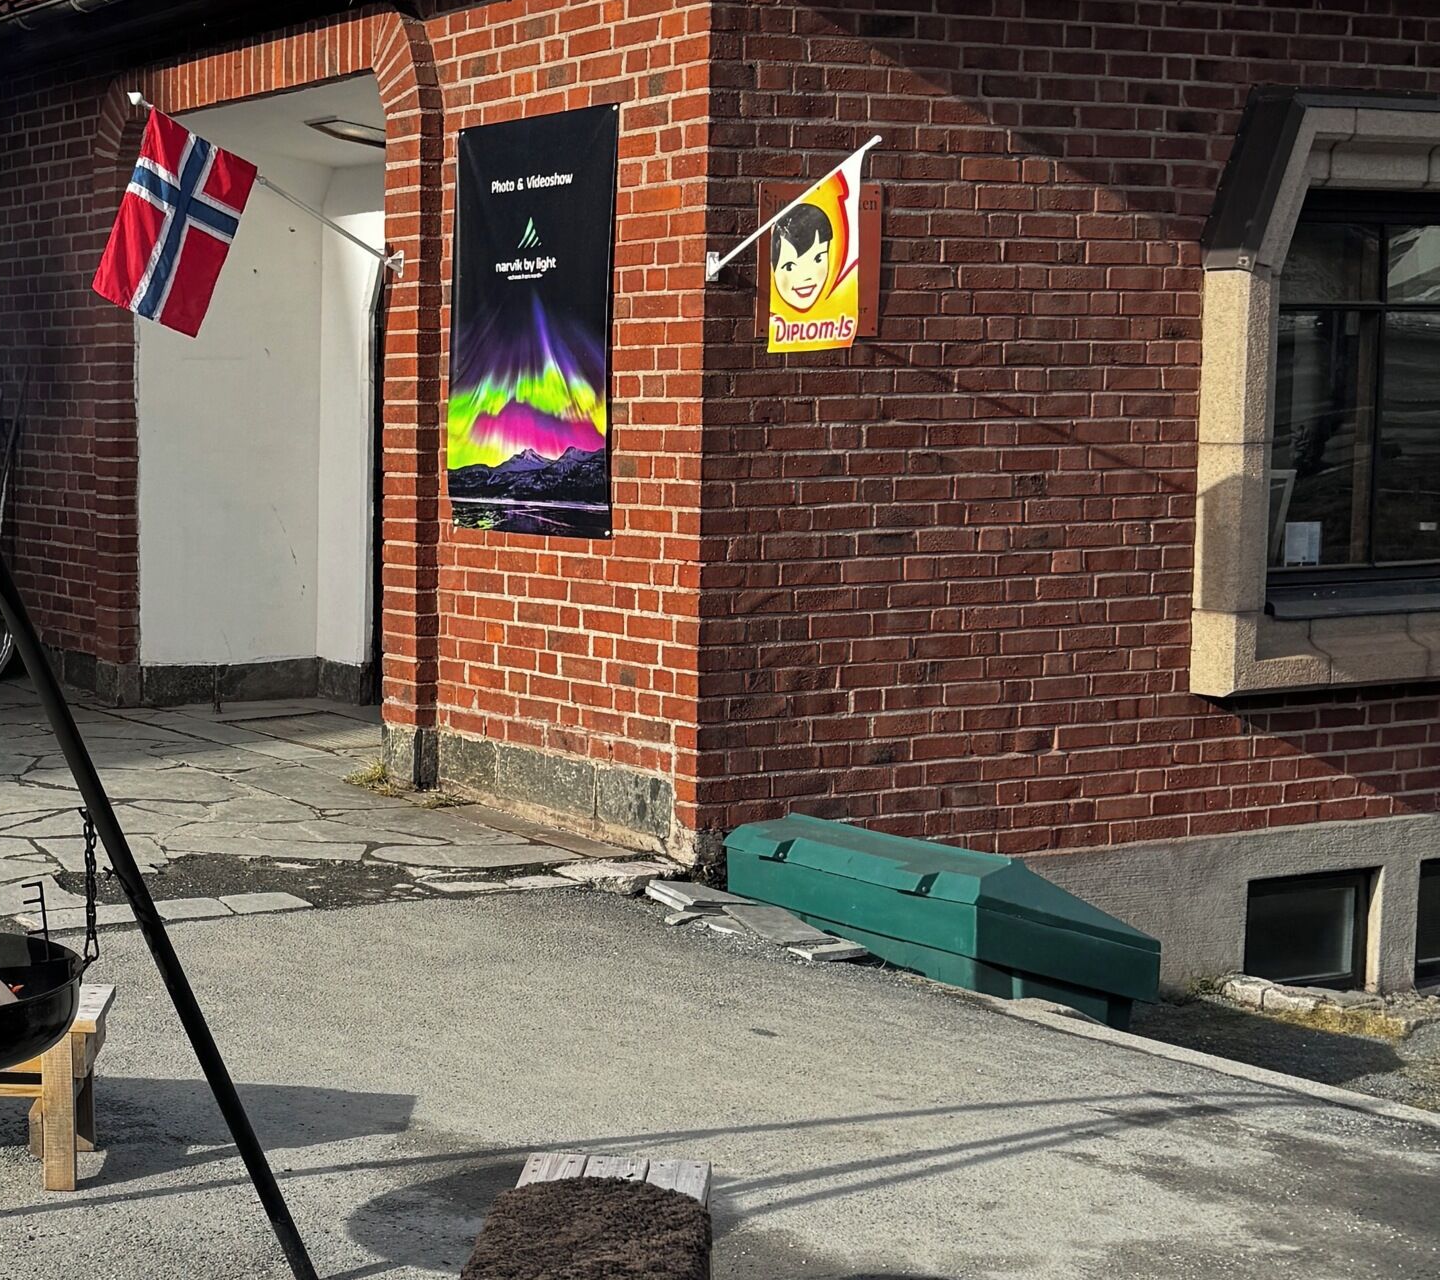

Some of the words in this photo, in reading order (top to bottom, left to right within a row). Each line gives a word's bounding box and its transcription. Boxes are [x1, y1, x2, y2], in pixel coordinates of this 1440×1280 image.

[491, 180, 515, 194] Photo
[516, 177, 524, 191] &
[526, 172, 573, 189] Videoshow
[495, 258, 523, 272] narvik
[523, 257, 535, 273] by
[535, 256, 557, 272] light
